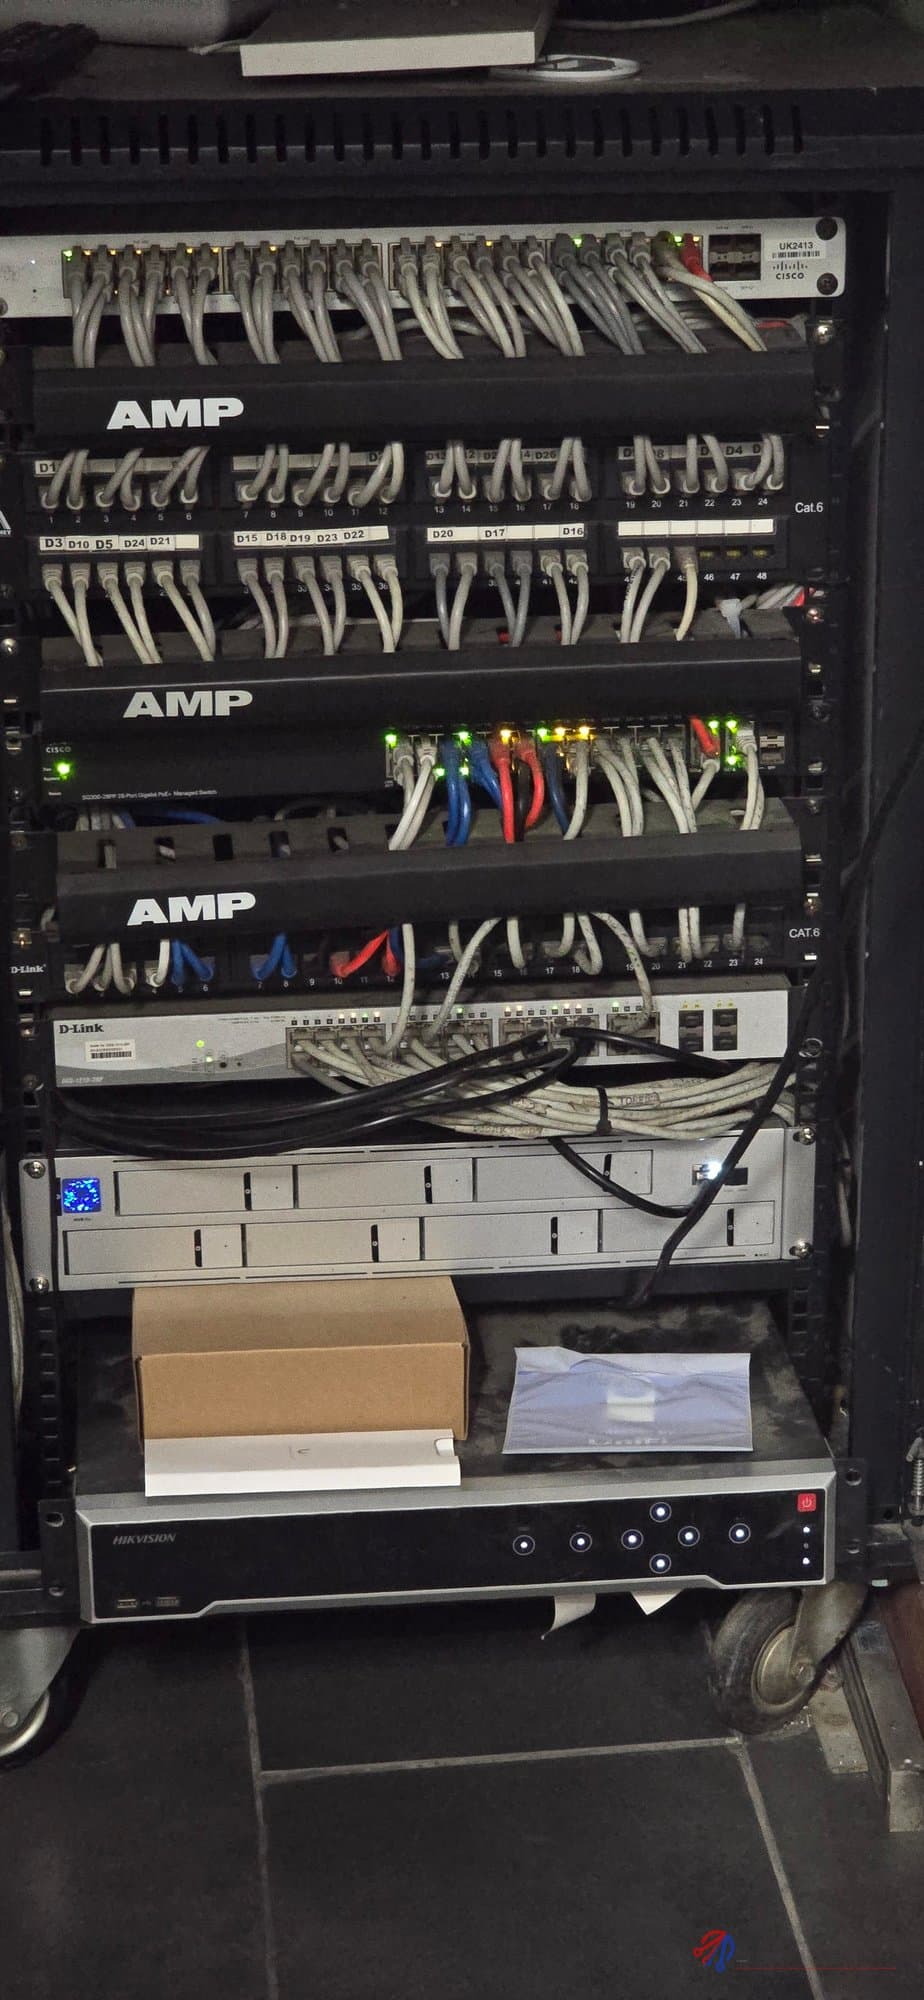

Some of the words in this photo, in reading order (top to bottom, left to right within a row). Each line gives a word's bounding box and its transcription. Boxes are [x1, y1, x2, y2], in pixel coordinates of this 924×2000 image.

[779, 242, 814, 250] UK2413
[775, 272, 805, 280] CISCO
[106, 397, 245, 430] AMP
[726, 446, 743, 456] D4
[434, 506, 444, 514] 13
[516, 504, 525, 512] 16
[570, 502, 580, 510] 18
[626, 501, 636, 509] 19
[652, 500, 662, 508] 20
[705, 499, 715, 507] 22
[732, 498, 742, 506] 23
[795, 502, 824, 512] Cat.6
[104, 514, 109, 523] 3
[158, 513, 164, 521] 5
[186, 513, 192, 521] 6
[270, 510, 276, 518] 8
[324, 509, 334, 517] 10
[236, 534, 258, 543] D15
[266, 532, 287, 541] D18
[290, 534, 311, 543] D19
[317, 534, 338, 543] D23
[343, 530, 364, 540] D22
[432, 530, 454, 538] D20
[484, 529, 505, 538] D17
[562, 527, 583, 536] D16
[45, 538, 63, 548] D3
[68, 540, 90, 549] D10
[95, 540, 113, 550] D5
[124, 538, 145, 548] D24
[150, 537, 170, 546] D21
[730, 572, 741, 580] 47
[757, 572, 767, 580] 48
[122, 690, 253, 718] AMP
[126, 892, 256, 926] AMP
[789, 928, 820, 938] CAT.6
[703, 960, 712, 968] 22
[754, 958, 763, 966] 24
[10, 964, 46, 974] D-Link
[440, 972, 450, 980] 13
[546, 966, 554, 974] 17
[572, 966, 580, 974] 18
[309, 978, 315, 986] 9
[202, 984, 208, 992] 6
[58, 1023, 104, 1034] D-Link
[112, 1533, 176, 1545] HIKVISION
